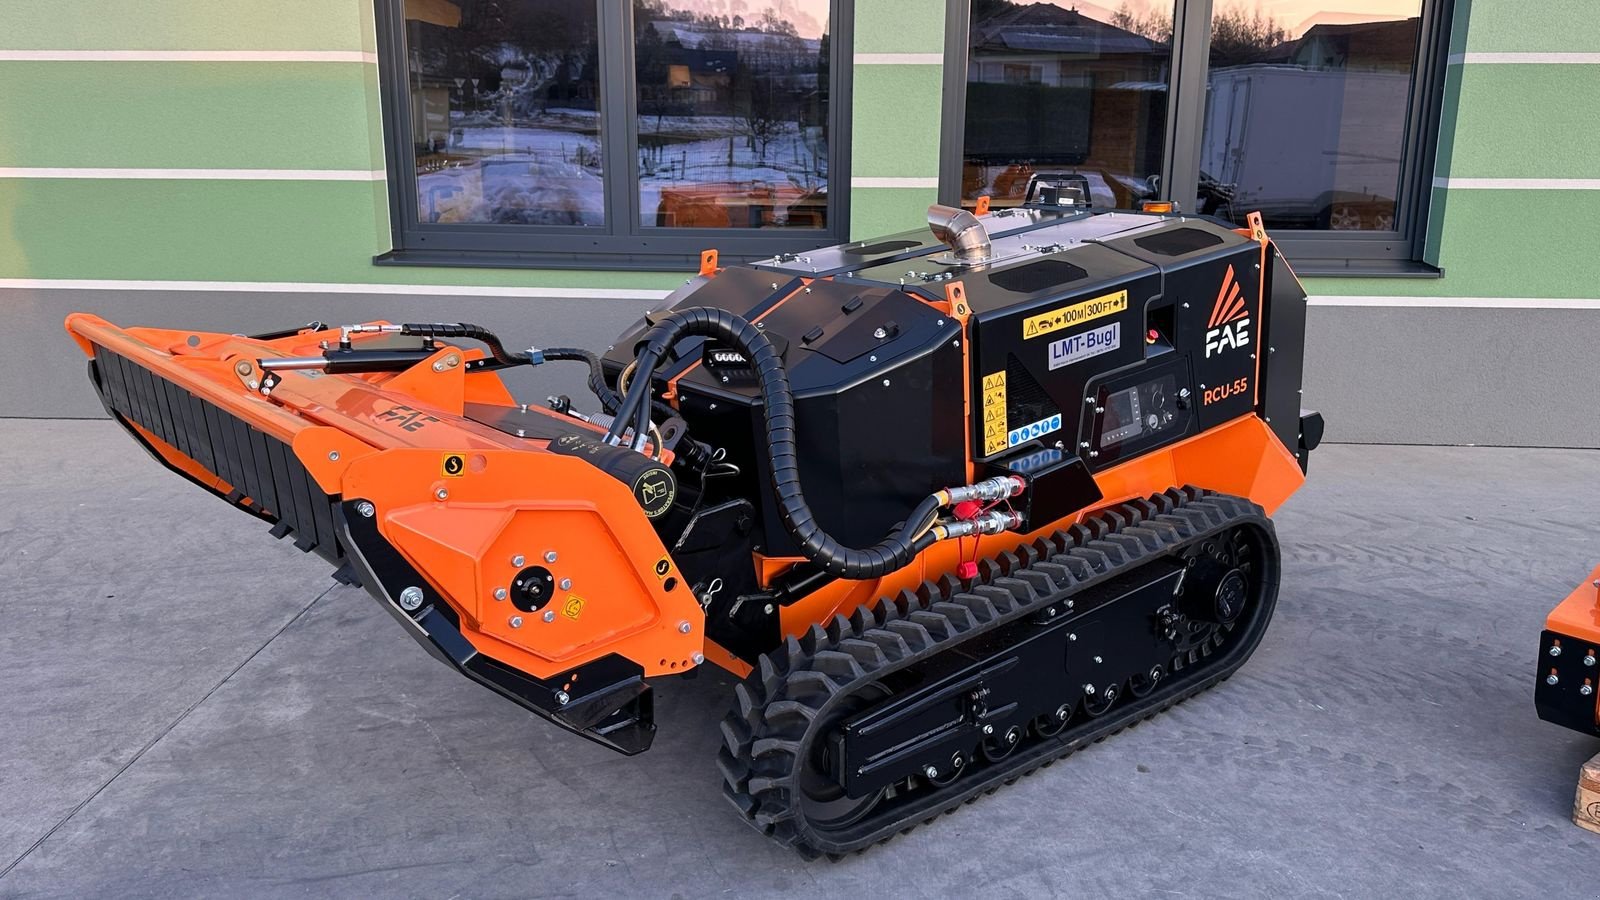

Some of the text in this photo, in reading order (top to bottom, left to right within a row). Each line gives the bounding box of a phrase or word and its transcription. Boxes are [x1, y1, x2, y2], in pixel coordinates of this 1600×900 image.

[1053, 325, 1116, 359] LMT-Bugl
[1205, 318, 1250, 359] FAE
[1203, 377, 1248, 406] RCU-55
[376, 405, 441, 432] FAE
